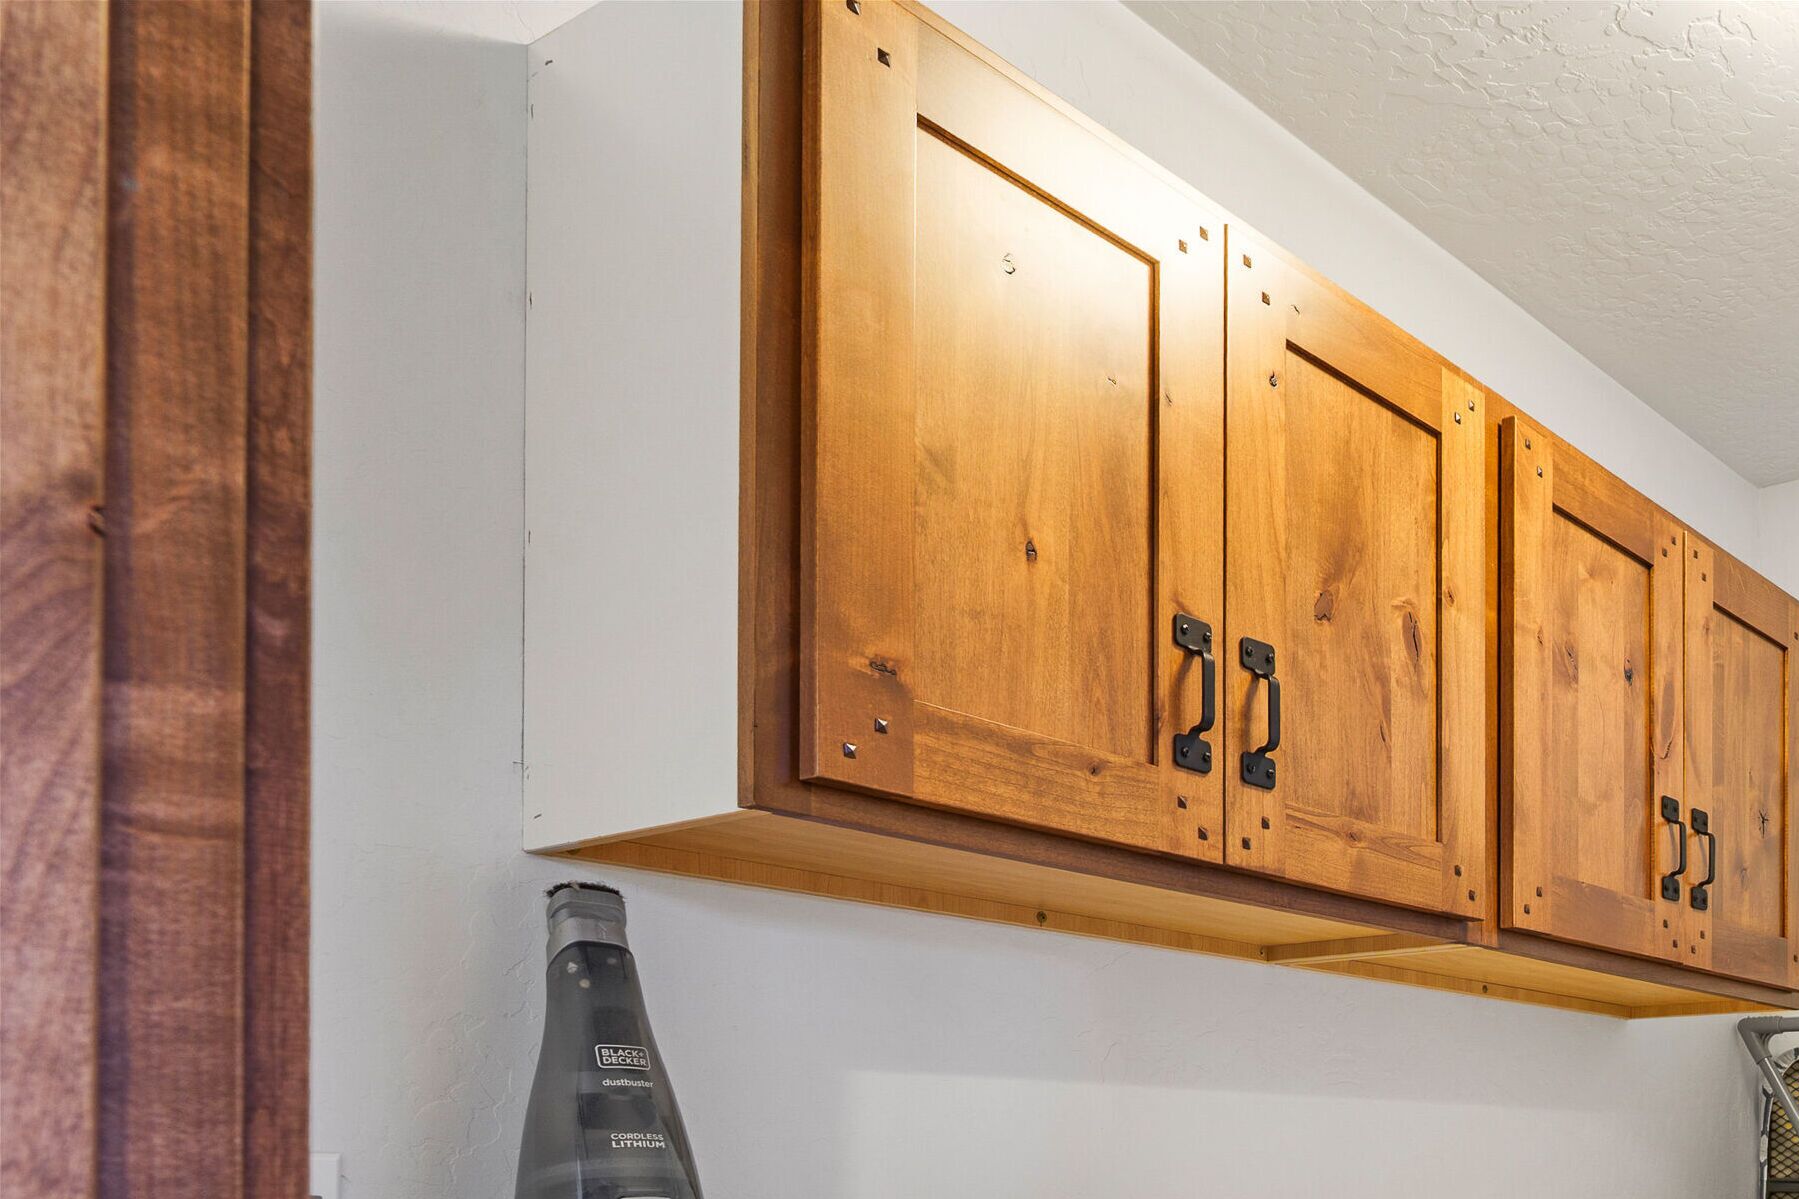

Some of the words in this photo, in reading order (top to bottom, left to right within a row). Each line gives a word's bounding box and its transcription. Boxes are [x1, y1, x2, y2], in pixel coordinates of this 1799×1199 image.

[601, 1048, 645, 1058] BLACK+
[603, 1056, 648, 1066] DECKER
[602, 1078, 653, 1088] dustbuster
[610, 1132, 665, 1141] CORDLESS
[612, 1140, 666, 1149] LITHIUM
